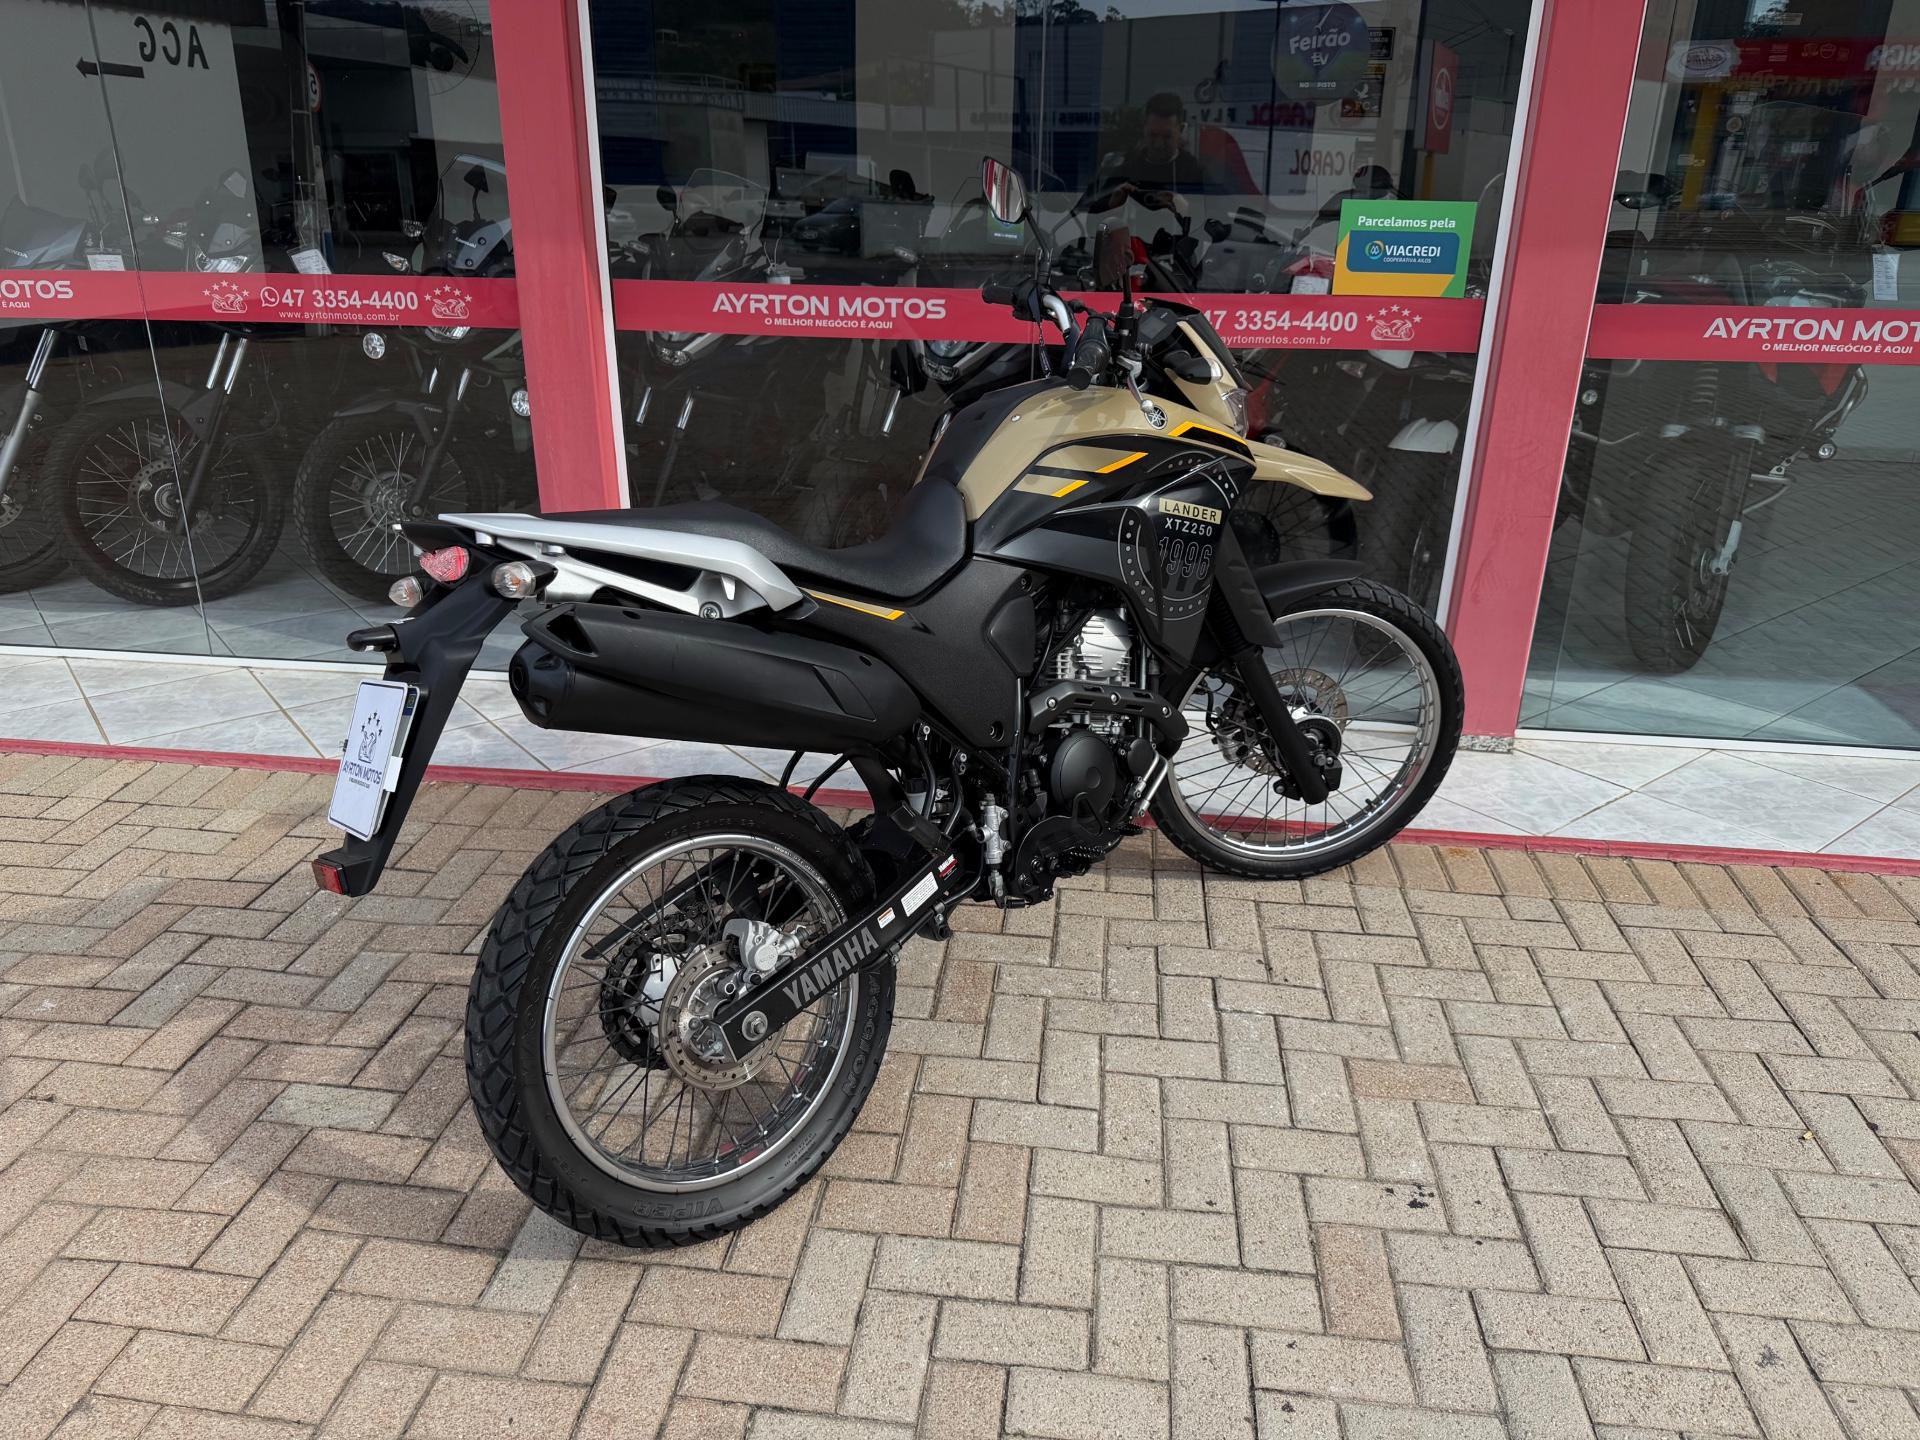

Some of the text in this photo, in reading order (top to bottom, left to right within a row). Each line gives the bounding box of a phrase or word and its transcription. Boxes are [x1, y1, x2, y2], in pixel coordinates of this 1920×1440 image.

[1289, 28, 1351, 55] Feirão
[1357, 215, 1457, 230] Parcelamos pela
[1383, 256, 1417, 264] COOPERATIVA
[1384, 245, 1442, 258] VIACREDI
[0, 279, 74, 299] OTOS
[281, 288, 419, 310] 47 3354-4400
[8, 301, 31, 309] AQUI
[278, 310, 400, 321] www.ayrtonmotos.com.br
[712, 292, 947, 320] AYRTON MOTOS
[764, 317, 893, 330] O MELHOR NEGÓCIO É AQUI
[1234, 310, 1359, 332] 3354-4400
[1702, 317, 1845, 341] AYRTON
[1221, 335, 1332, 346] ayrtonmotos.com.br
[1761, 343, 1914, 354] O MELHOR NEGÓCIO É AQUI
[1164, 500, 1218, 522] LANDER
[1165, 517, 1213, 537] XTZ250
[1158, 536, 1213, 580] 1996
[342, 761, 365, 778] AYRTON
[363, 766, 383, 785] MOTOS
[782, 926, 880, 1009] YAMAHA
[631, 1196, 725, 1219] VIPER
